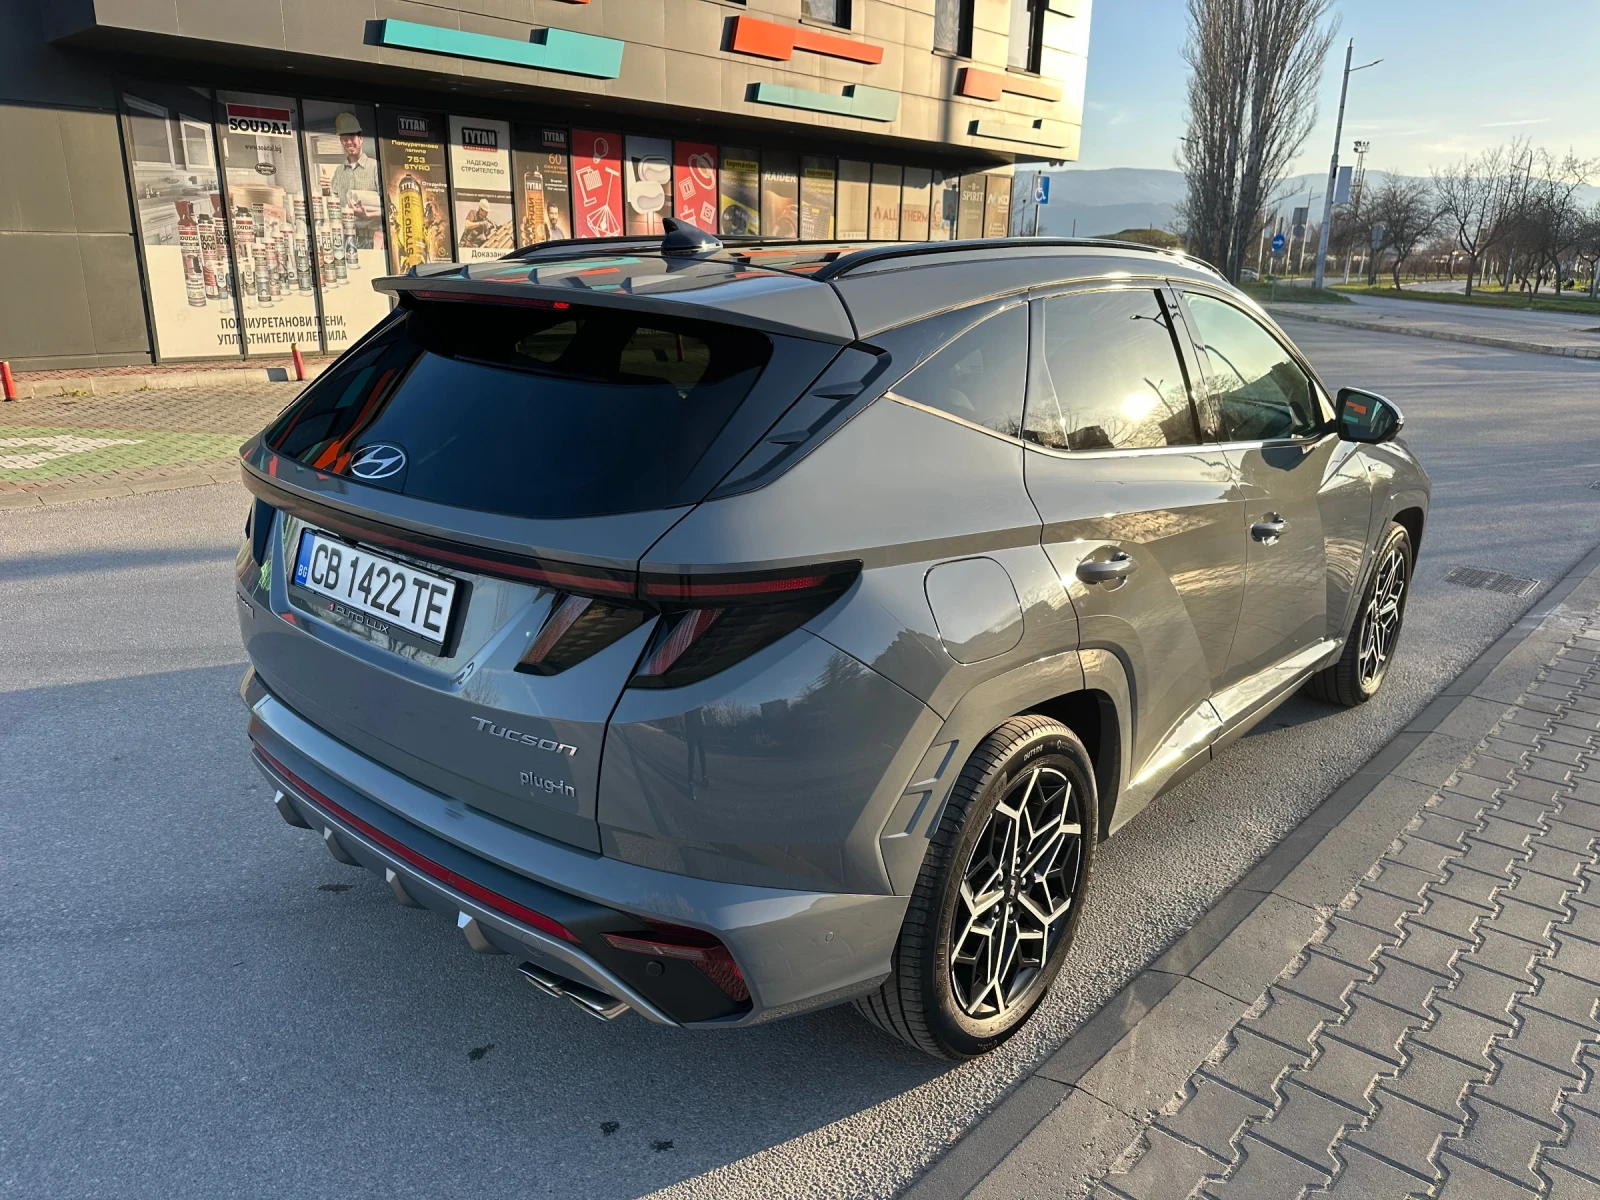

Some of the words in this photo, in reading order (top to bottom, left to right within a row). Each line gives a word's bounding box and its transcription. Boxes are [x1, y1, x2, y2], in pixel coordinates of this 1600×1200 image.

[229, 118, 292, 135] SOUDAL
[400, 118, 426, 131] TYTAN
[463, 129, 496, 145] TYTAN
[543, 131, 565, 143] TYTAN
[407, 156, 426, 164] 753
[466, 159, 499, 167] НАДЕЖДНО
[549, 153, 562, 165] 60
[726, 160, 757, 169] topmaster
[461, 166, 505, 175] СТРОИТЕЛСТВО
[764, 172, 797, 183] RAIDER
[962, 190, 984, 202] SPIRIT
[883, 208, 898, 221] ALL
[406, 218, 414, 255] STYRO
[297, 332, 304, 342] И
[297, 564, 309, 578] BG
[311, 543, 342, 590] CB
[347, 555, 406, 618] 1422
[411, 577, 448, 633] TE
[336, 604, 364, 625] AUTO
[366, 619, 391, 635] LUX
[520, 771, 576, 798] plug-in
